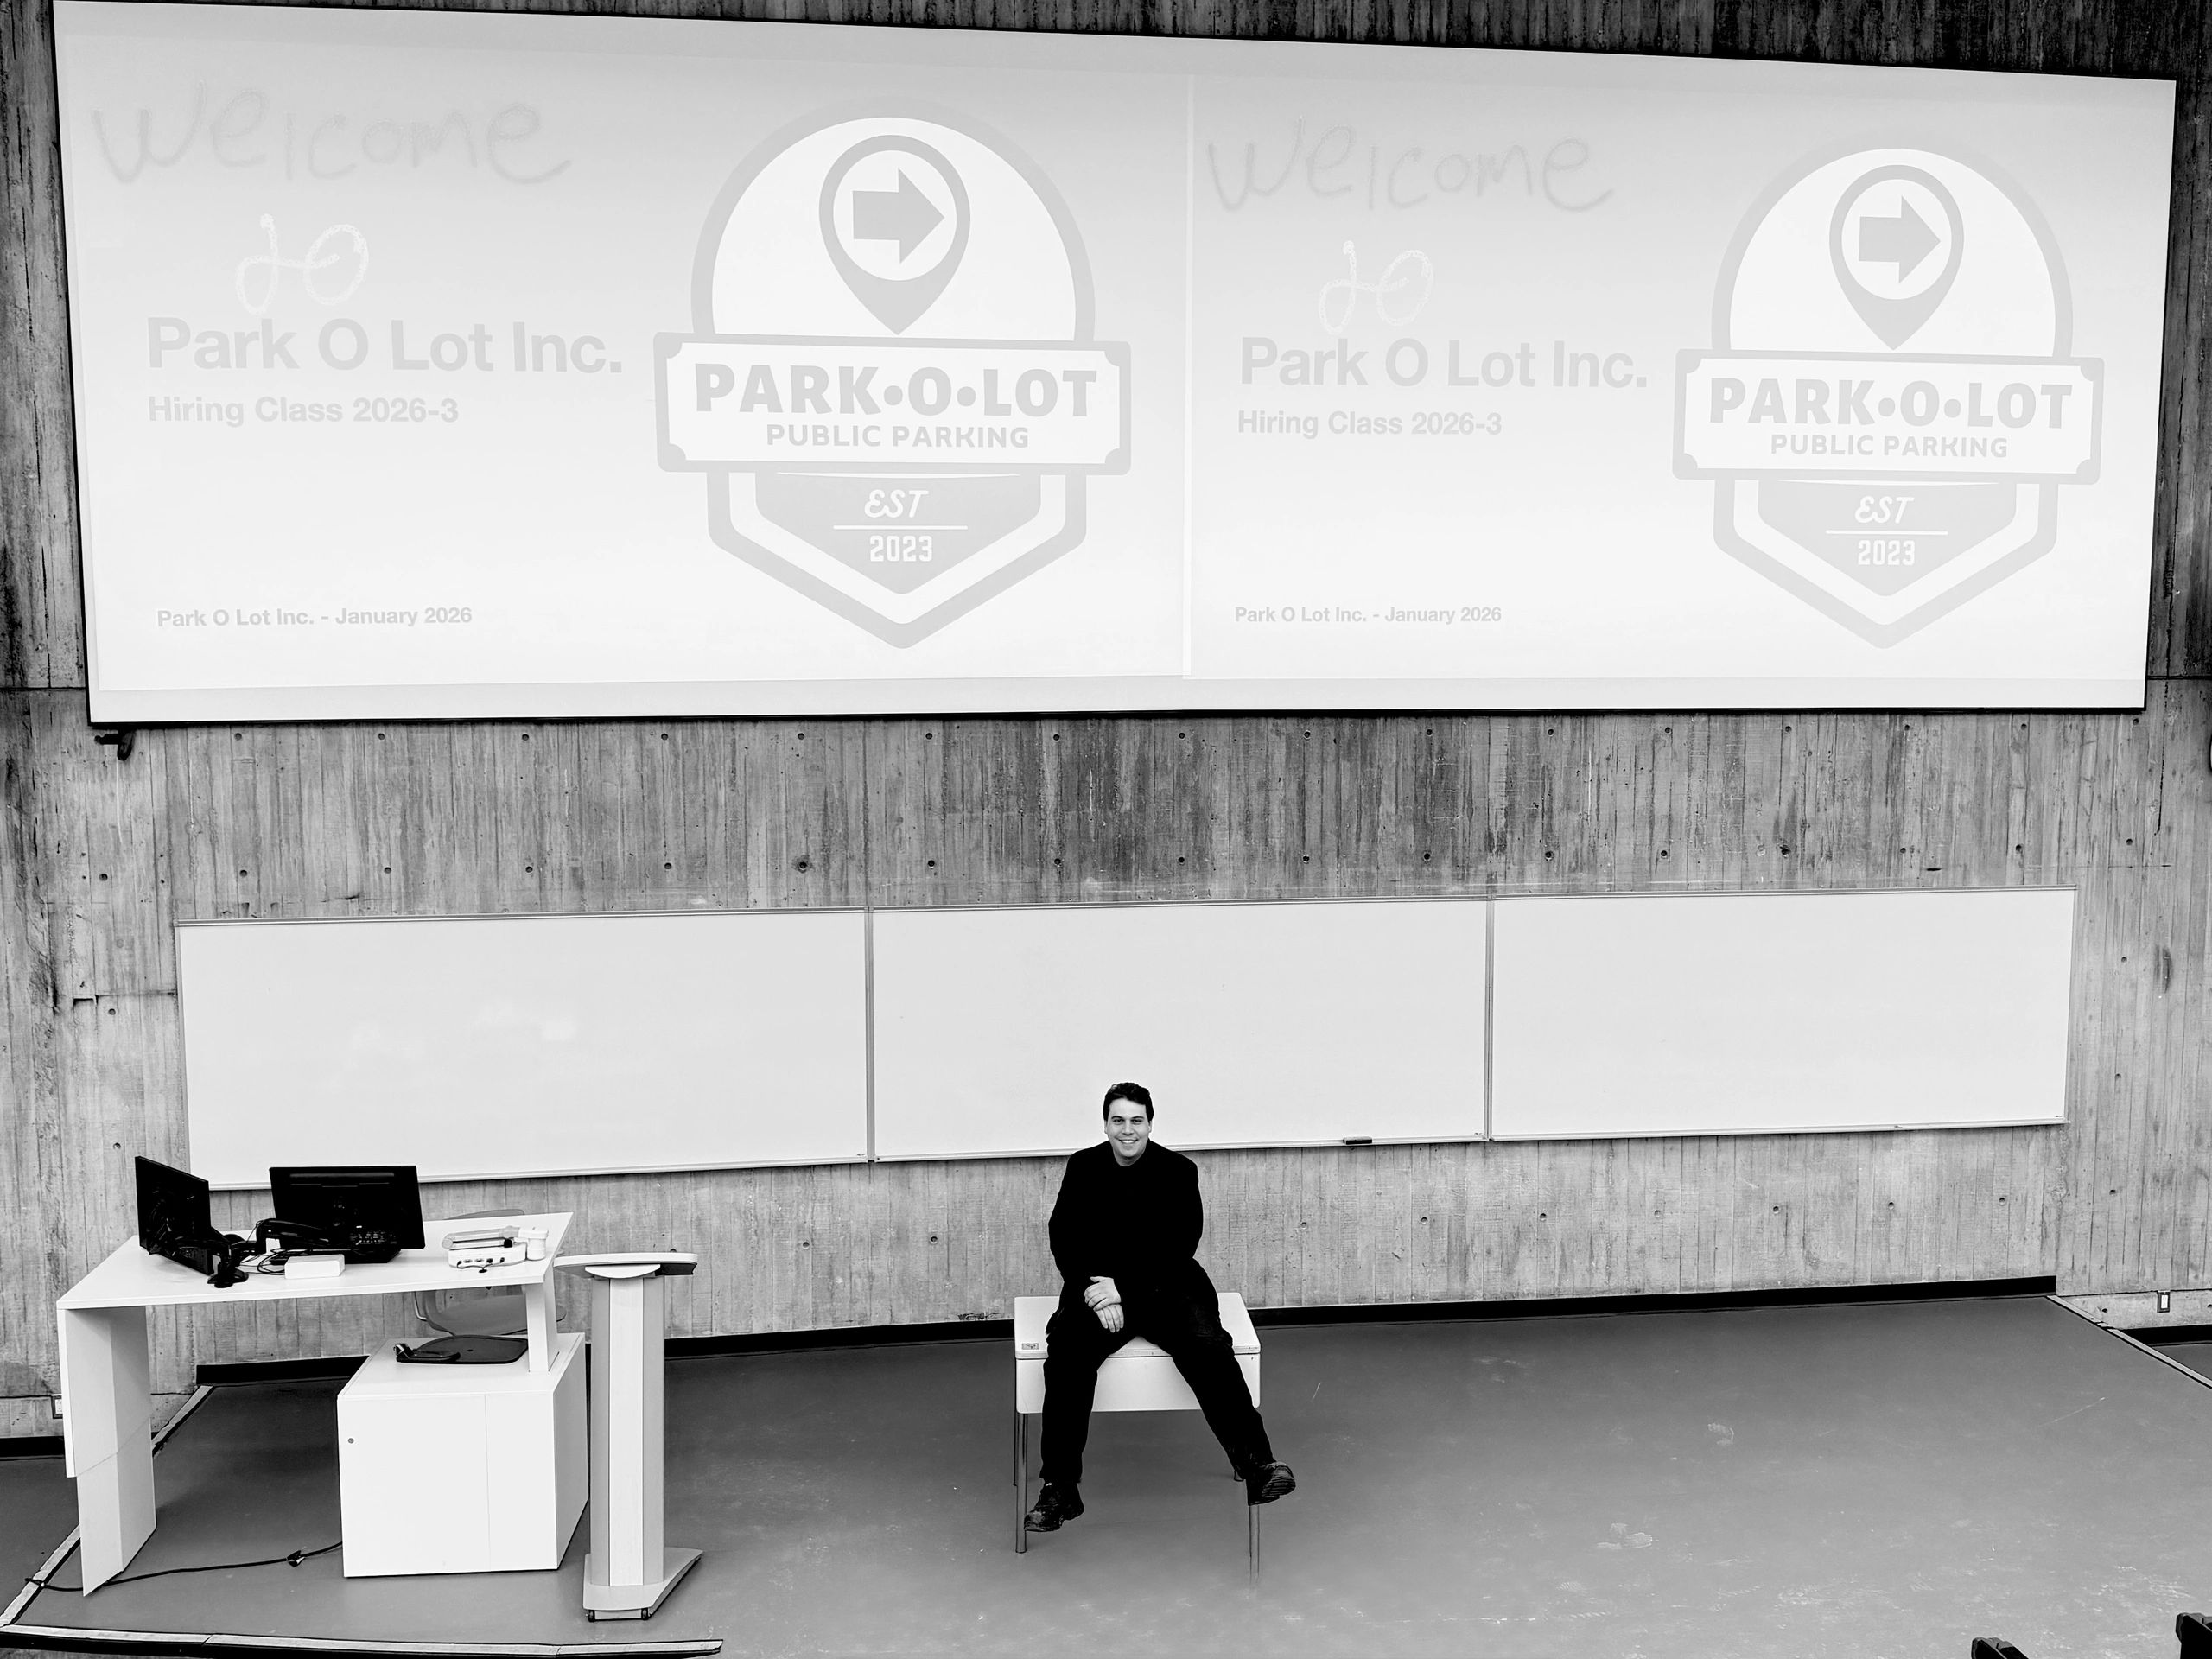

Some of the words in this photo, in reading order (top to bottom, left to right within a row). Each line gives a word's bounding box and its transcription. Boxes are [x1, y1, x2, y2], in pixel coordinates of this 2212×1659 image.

[90, 79, 573, 185] Welcome
[1207, 115, 1614, 212] Welcome
[148, 317, 300, 369] Park
[318, 318, 368, 370] O
[391, 320, 493, 372] Lot
[513, 322, 622, 373] Inc.
[1242, 337, 1368, 385] Park
[1385, 338, 1428, 386] O
[1448, 340, 1535, 387] Lot
[1553, 341, 1647, 388] Inc.
[149, 397, 244, 427] Hiring
[255, 397, 343, 422] Class
[353, 397, 458, 423] 2026-3
[1239, 410, 1318, 439] Hiring
[1328, 411, 1402, 435] Class
[1412, 412, 1502, 435] 2026-3
[767, 424, 880, 447] PUBLIC
[893, 426, 1027, 448] PARKING
[1771, 435, 1873, 455] PUBLIC
[1885, 436, 2007, 458] PARKING
[865, 489, 928, 518] EST
[1855, 496, 1914, 524] EST
[870, 536, 932, 562] 2023
[1859, 540, 1915, 565] 2023
[158, 609, 207, 626] Park
[213, 609, 229, 626] O
[237, 609, 270, 626] Lot
[277, 608, 314, 625] Inc.
[335, 608, 418, 626] January
[425, 607, 472, 623] 2026
[1236, 607, 1275, 621] Park
[1281, 607, 1295, 622] O
[1302, 607, 1330, 621] Lot
[1336, 607, 1366, 622] Inc.
[1385, 607, 1455, 625] January
[1461, 607, 1502, 621] 2026
